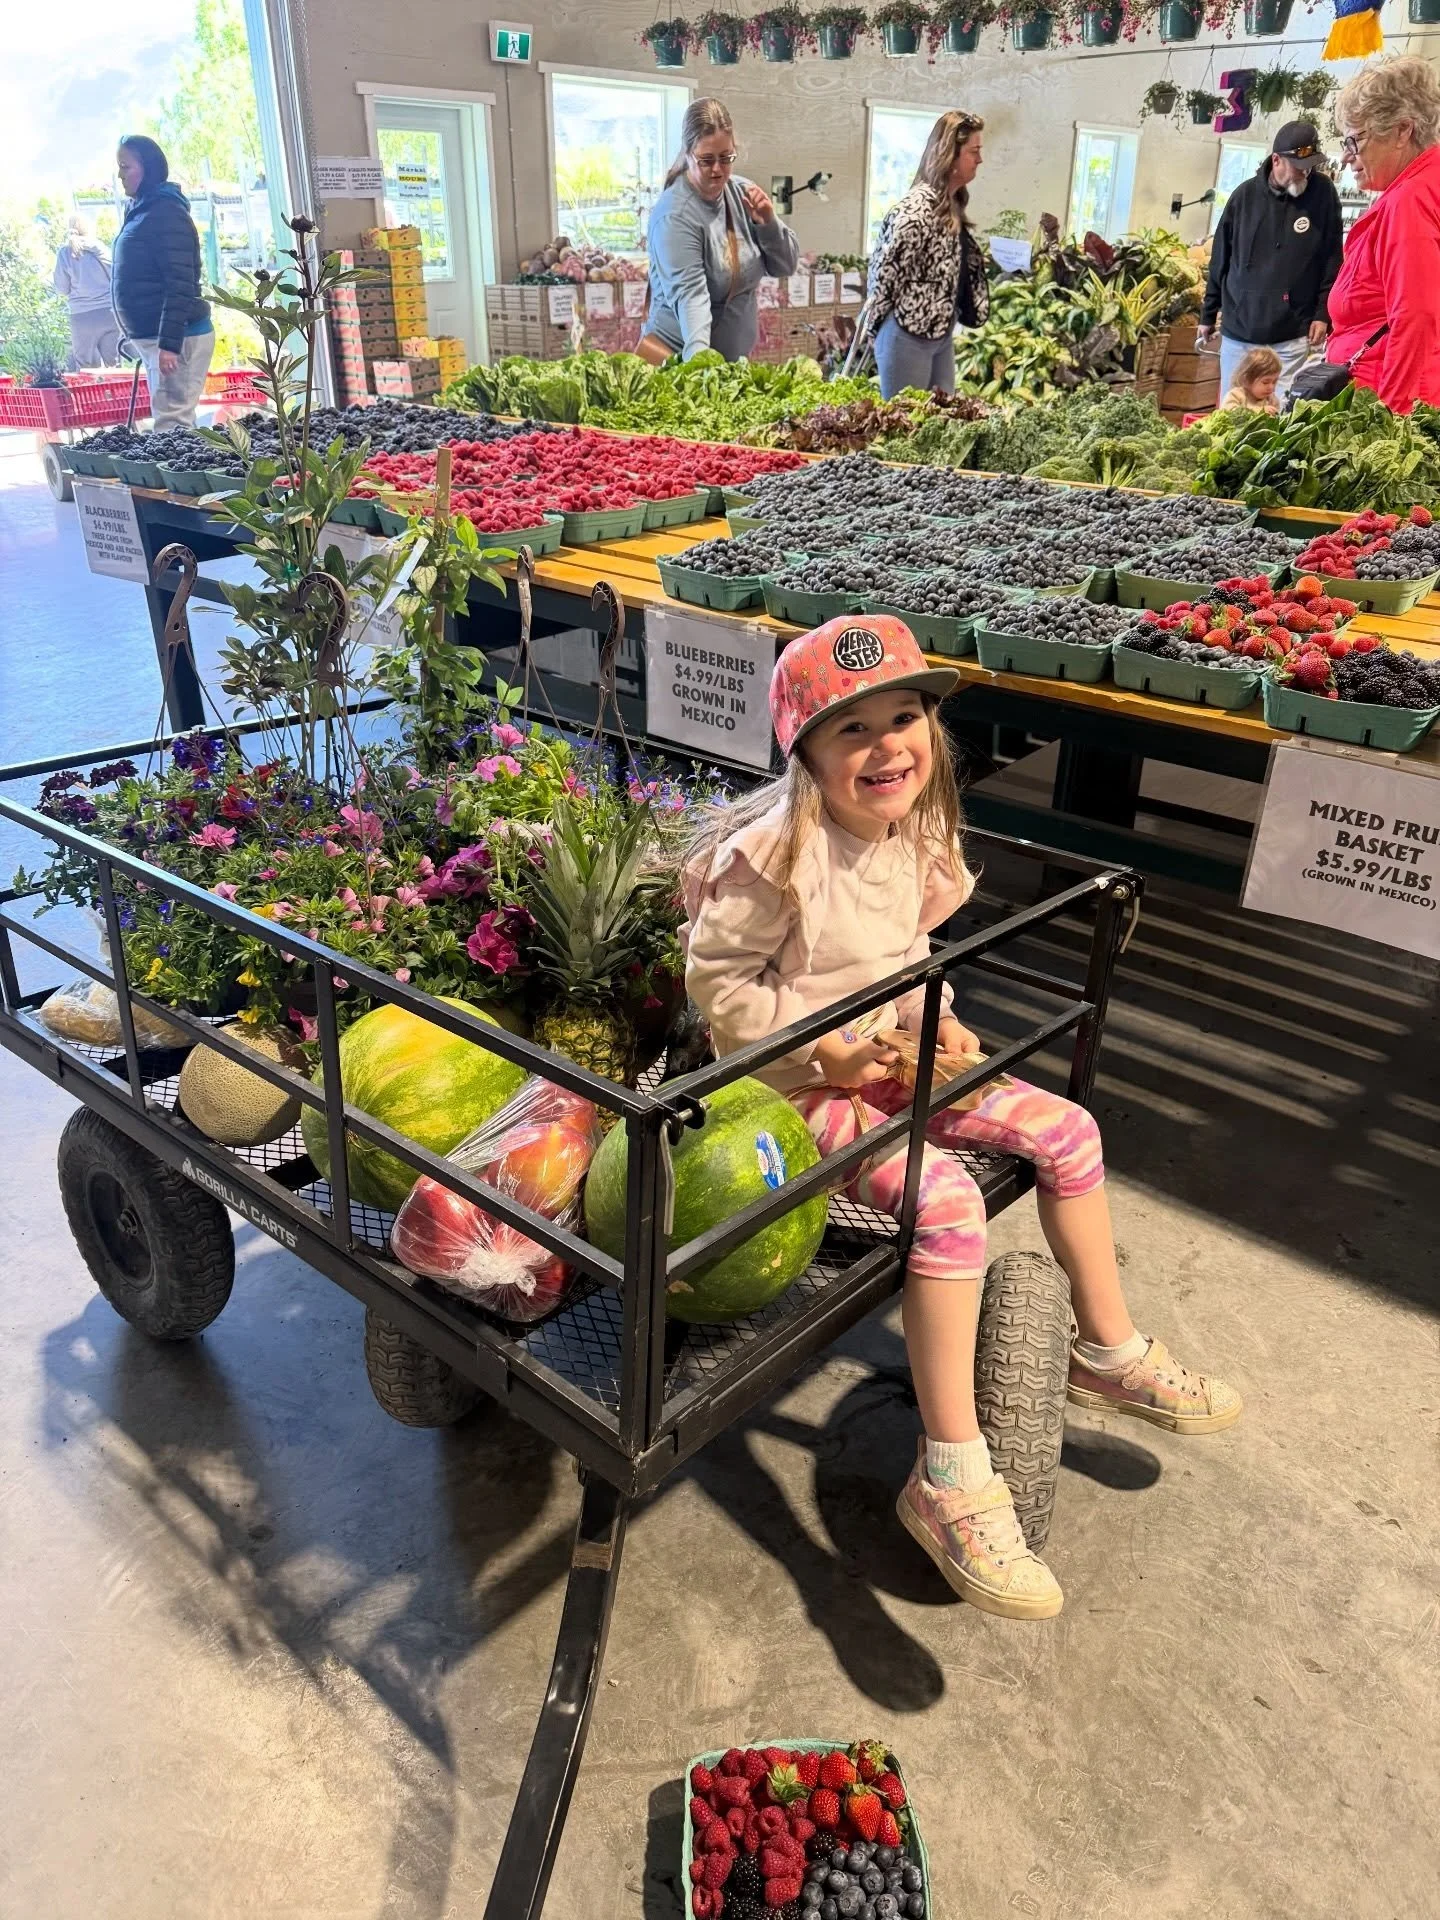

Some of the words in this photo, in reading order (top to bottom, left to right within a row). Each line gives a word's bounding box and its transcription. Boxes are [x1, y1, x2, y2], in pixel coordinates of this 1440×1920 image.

[84, 505, 130, 521] BLACKBERRIES
[86, 540, 103, 550] MEXICO
[104, 543, 115, 551] AND
[115, 545, 125, 553] ARE
[92, 531, 105, 541] THESE
[106, 534, 120, 543] CAME
[120, 537, 133, 545] FROM
[98, 551, 110, 559] WITH
[665, 641, 755, 676] BLUEBERRIES
[837, 630, 878, 656] HEAD
[840, 645, 881, 668] STER
[674, 662, 744, 694] $4.99/LBS
[671, 682, 725, 709] GROWN
[730, 697, 746, 714] IN
[680, 703, 736, 731] MEXICO
[1308, 799, 1385, 831] MIXED
[1391, 818, 1440, 847] FRU
[1335, 829, 1426, 865] BASKET
[1315, 848, 1433, 892] $5.99/LBS
[1301, 867, 1357, 889] (GROWN
[1359, 881, 1375, 893] IN
[1378, 886, 1437, 911] MEXICO)
[195, 1167, 249, 1215] GORILLA
[250, 1205, 297, 1248] CARTS
